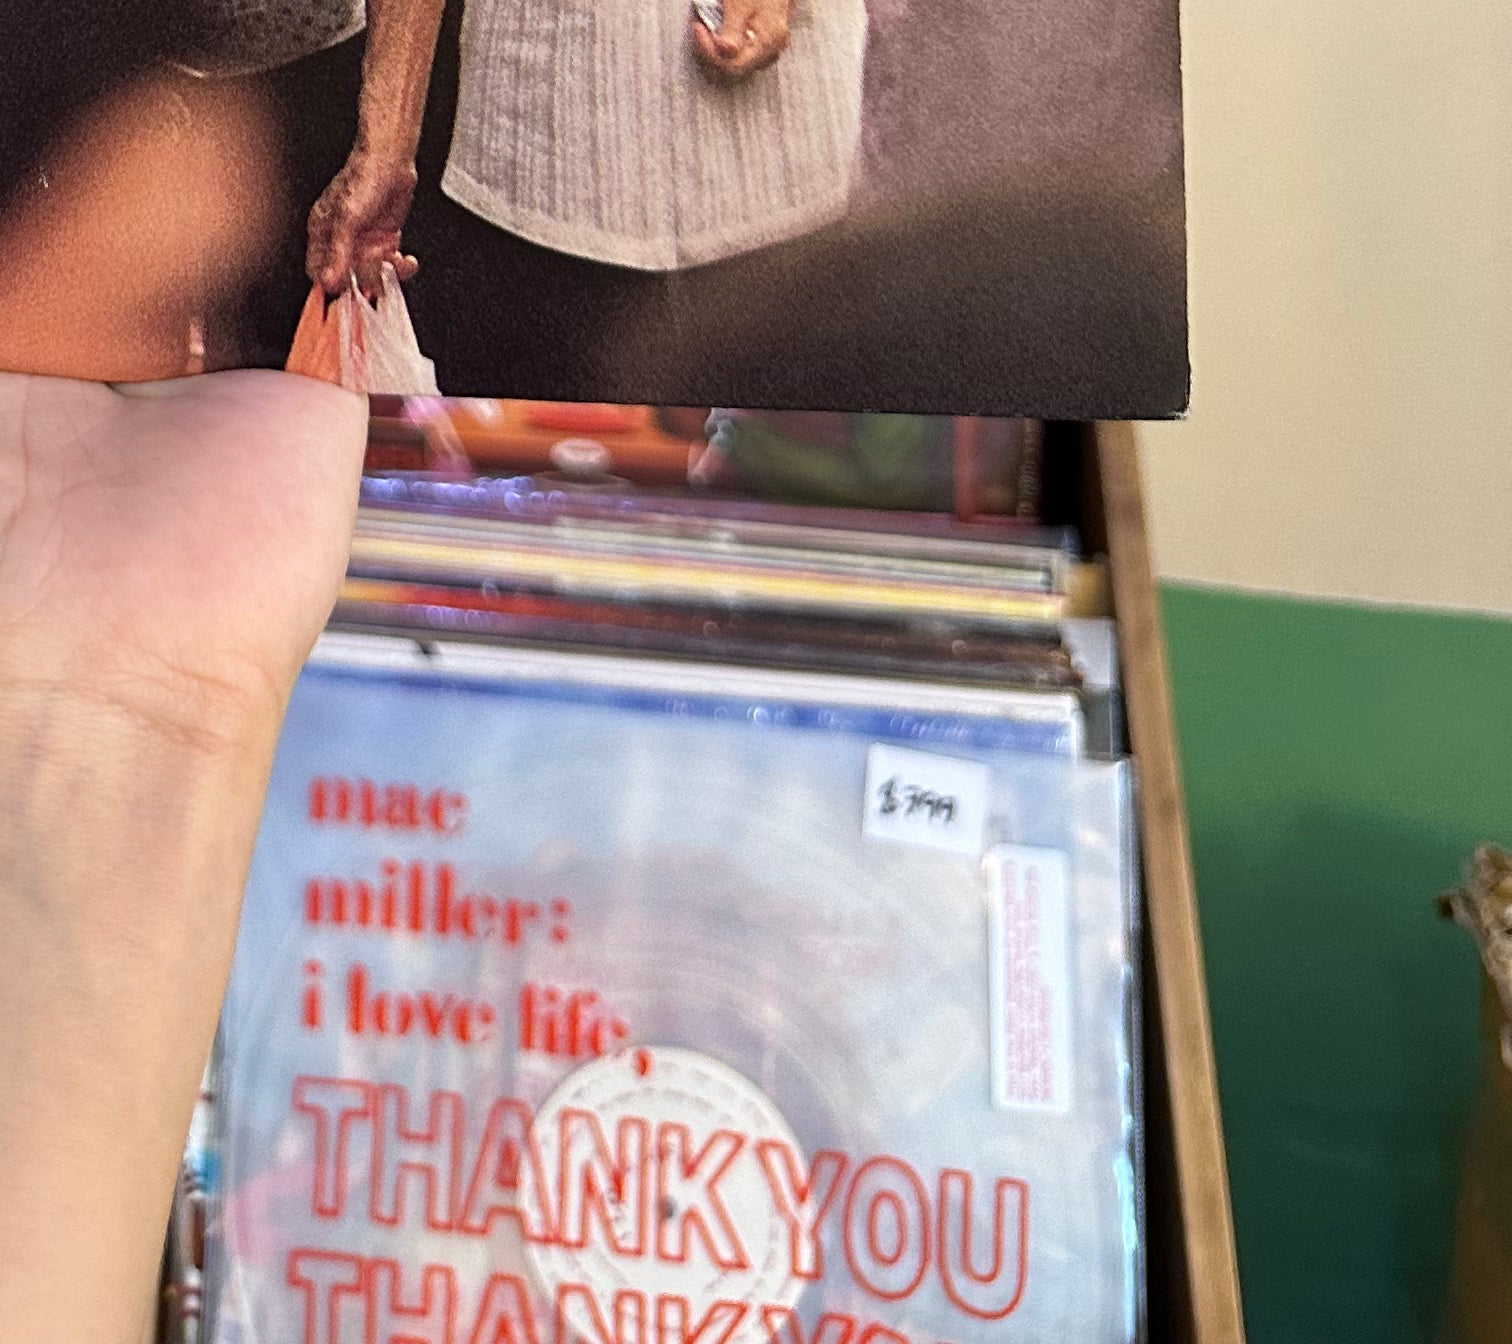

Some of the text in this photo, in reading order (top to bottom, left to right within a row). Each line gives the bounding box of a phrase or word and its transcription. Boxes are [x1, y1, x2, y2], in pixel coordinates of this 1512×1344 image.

[308, 775, 468, 835] mac
[303, 858, 570, 949] miller:
[301, 959, 323, 1030] i
[345, 962, 496, 1046] love
[293, 1074, 1030, 1321] THANK YOU
